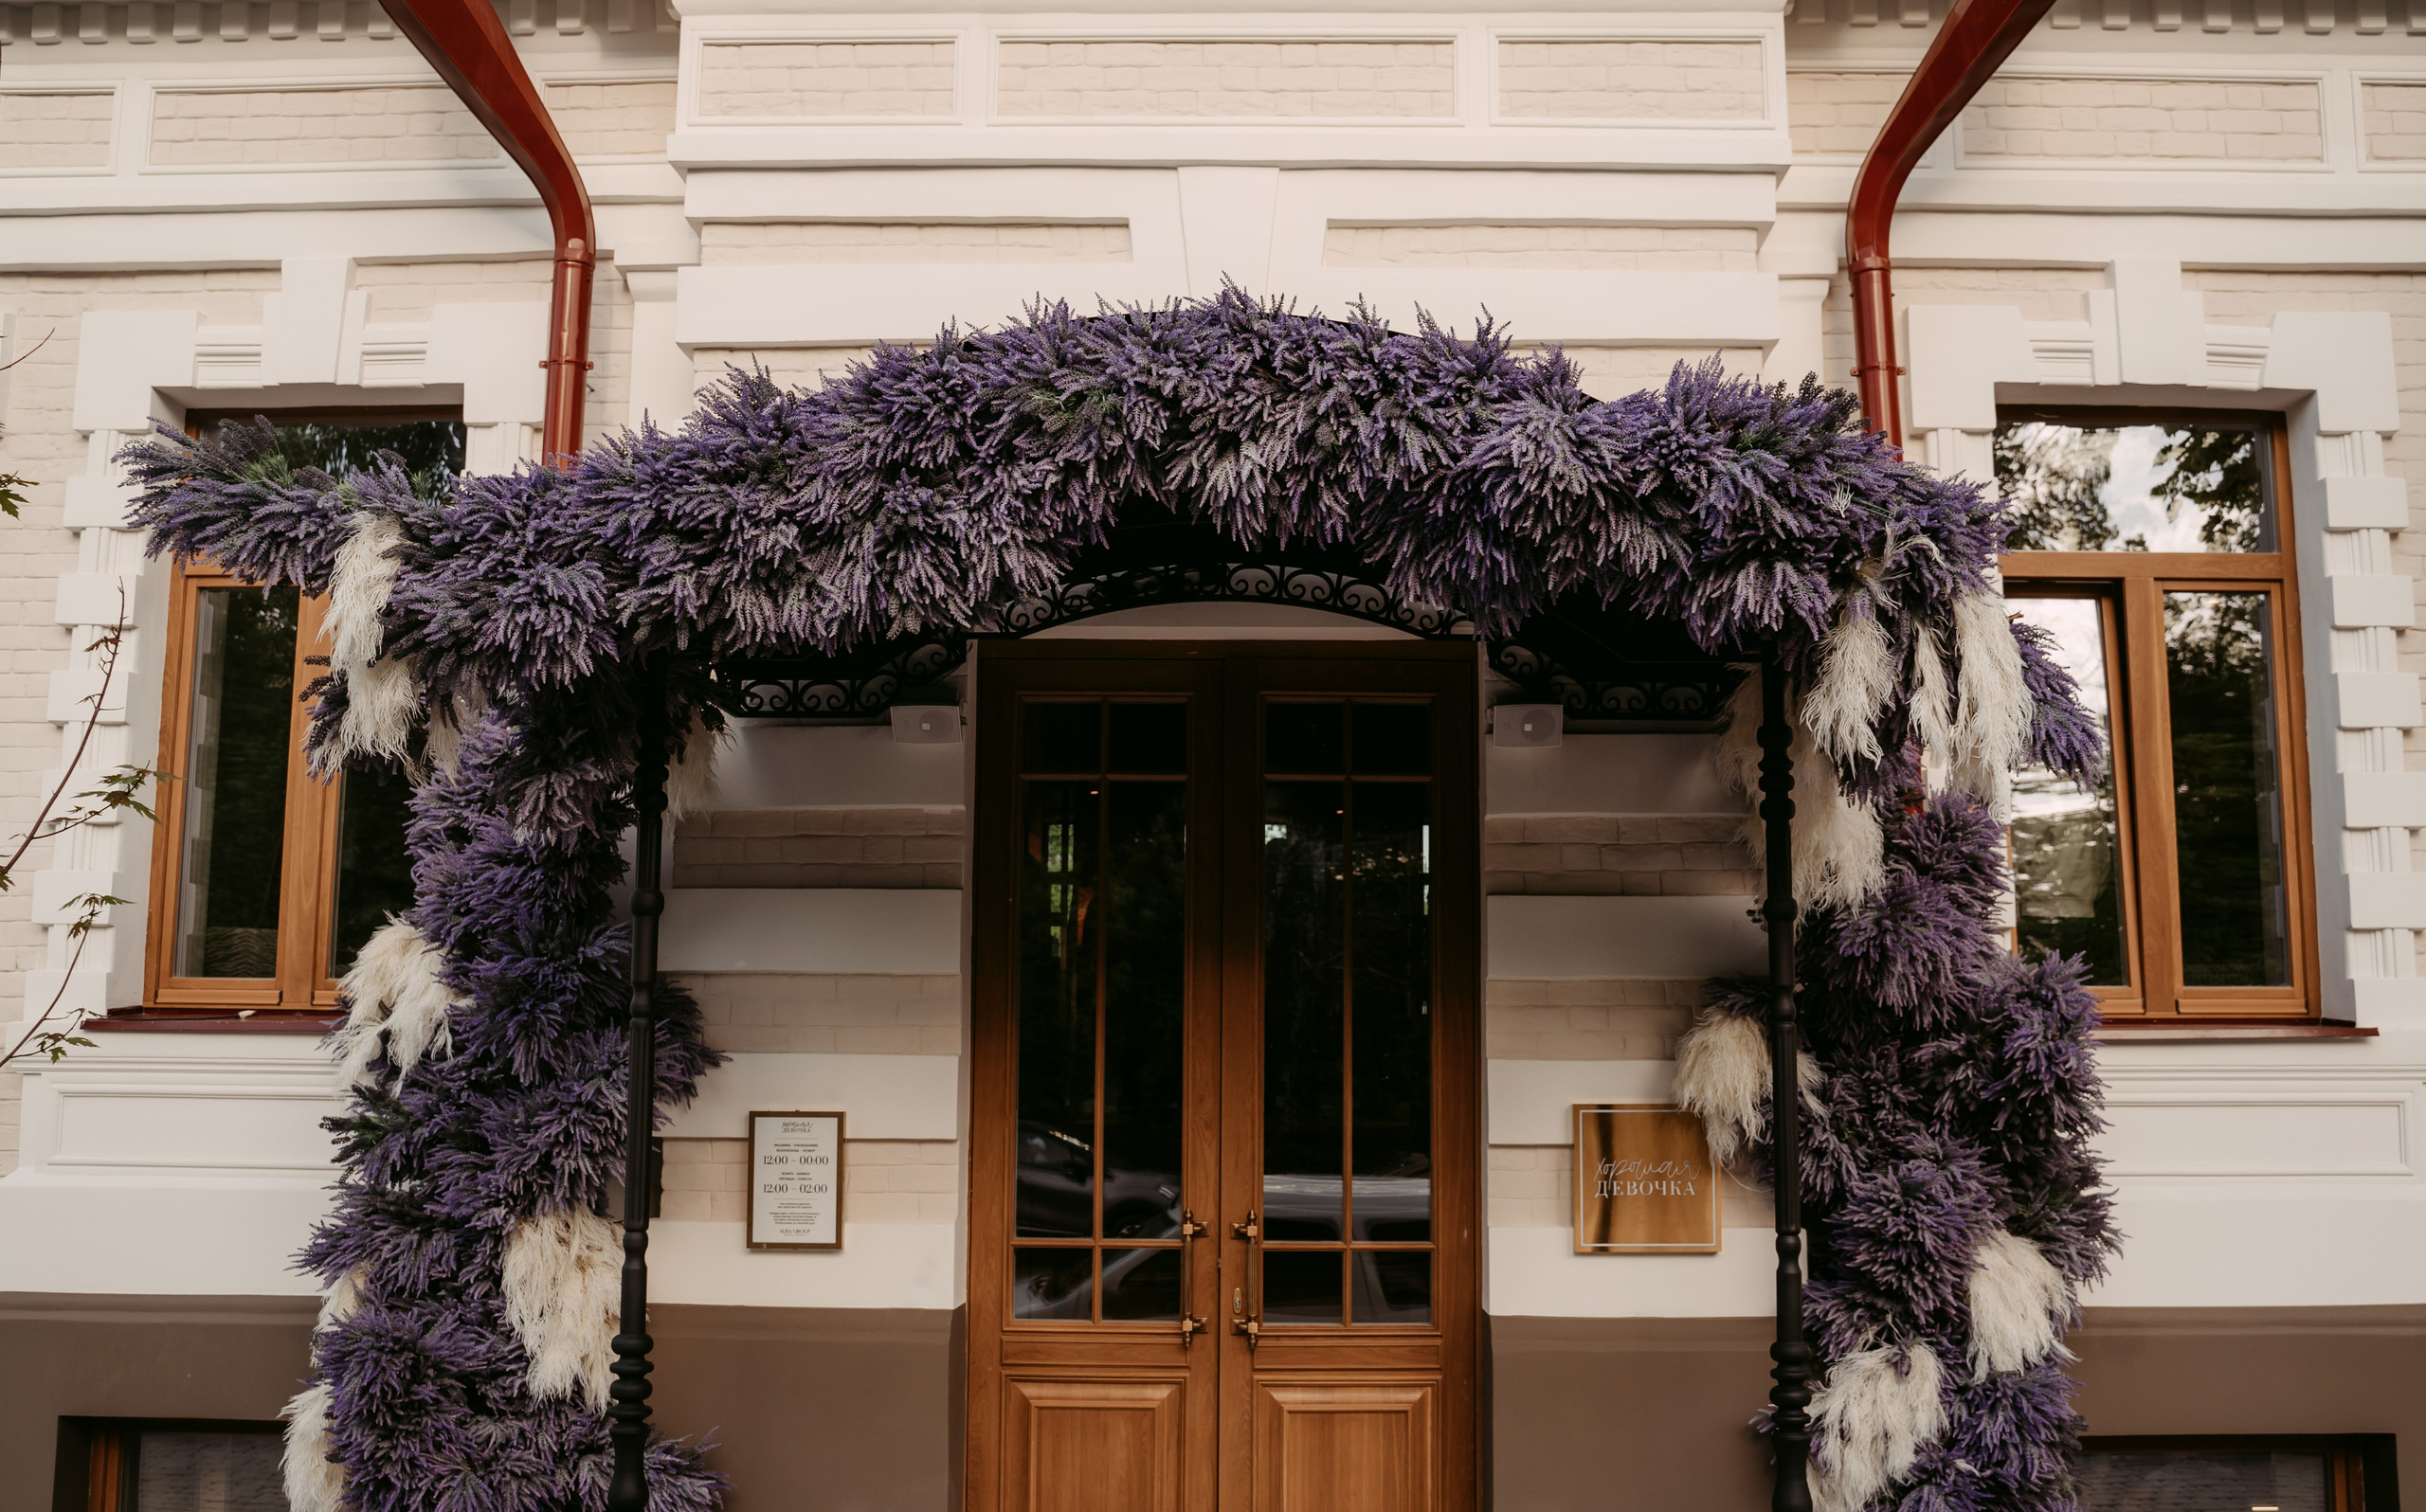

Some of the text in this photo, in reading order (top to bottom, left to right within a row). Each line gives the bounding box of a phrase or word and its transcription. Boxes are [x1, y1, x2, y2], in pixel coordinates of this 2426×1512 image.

[764, 1155, 788, 1165] 12:00
[799, 1155, 829, 1165] 00:00
[764, 1183, 788, 1194] 12:00
[799, 1183, 828, 1194] 02:00
[1594, 1180, 1695, 1198] ДЕВОЧКА
